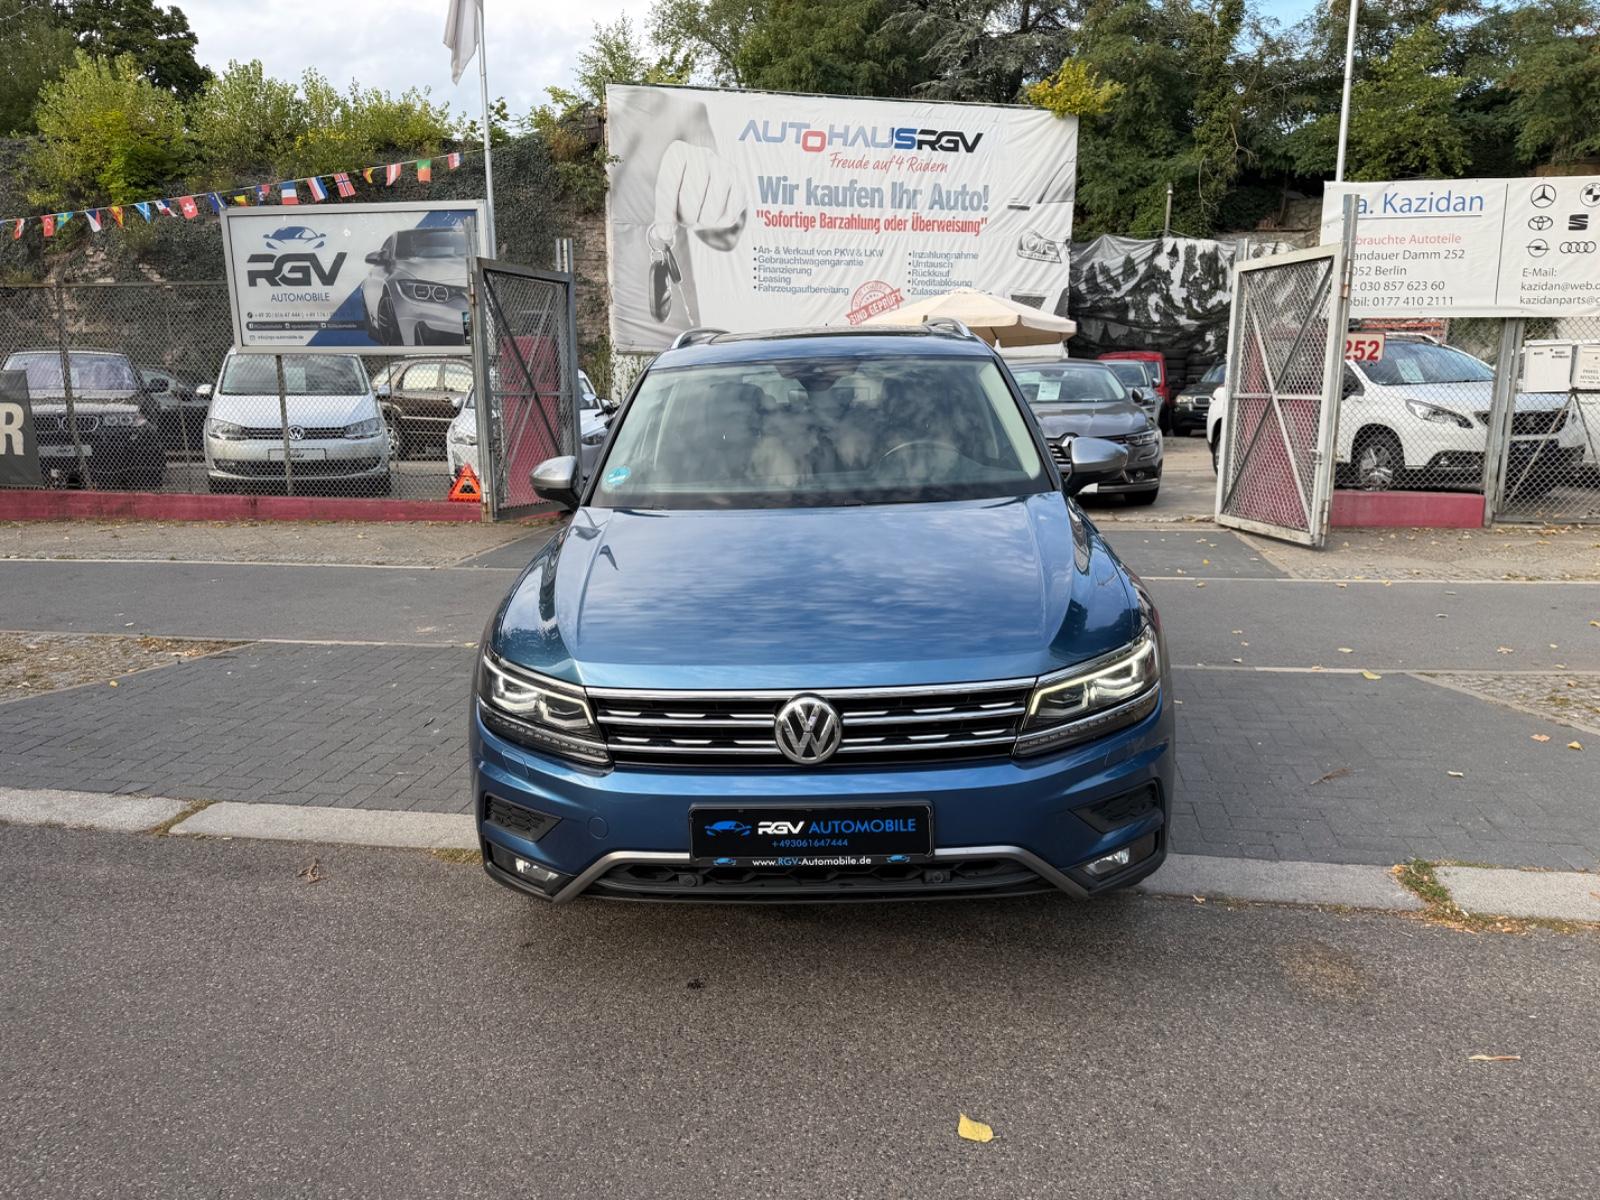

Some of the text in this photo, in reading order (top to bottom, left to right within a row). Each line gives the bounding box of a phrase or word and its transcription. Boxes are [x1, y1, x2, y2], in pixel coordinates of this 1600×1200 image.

[829, 152, 870, 170] Freude
[872, 154, 893, 175] auf
[894, 155, 903, 172] 4
[757, 175, 990, 212] Wir kaufen Ihr Auto!
[1383, 190, 1484, 214] Kazidan
[756, 209, 988, 237] "Sofortige Barzahlung oder Überweisung"
[1354, 233, 1462, 246] brauchte Autoteile
[774, 246, 781, 255] &
[782, 246, 815, 256] Verkauf
[834, 247, 855, 256] PKW
[864, 248, 884, 258] LKW
[912, 249, 979, 260] Inzahlungnahme
[1354, 249, 1465, 261] andauer Damm 252
[757, 255, 864, 268] Gebrauchtwagengarantie
[911, 260, 953, 269] Umtausch
[246, 251, 348, 287] RGV
[757, 265, 812, 276] Finanzierung
[911, 268, 950, 278] Rückkauf
[1353, 265, 1407, 276] 052 Berlin
[1522, 267, 1557, 277] E-Mail:
[757, 274, 792, 285] Leasing
[911, 277, 973, 288] Kreditablösung
[757, 283, 849, 296] Fahrzeugaufbereitung
[1360, 281, 1381, 291] 030
[1383, 281, 1405, 291] 857
[1407, 281, 1428, 291] 623
[1431, 280, 1445, 290] 60
[270, 292, 331, 302] AUTOMOBILE
[1373, 296, 1400, 306] 0177
[1403, 296, 1424, 306] 410
[1427, 296, 1454, 306] 2111
[757, 818, 917, 835] RGV AUTOMOBILE
[772, 838, 848, 848] +493061647444
[752, 856, 872, 867] www.RGV-Automobile.de
